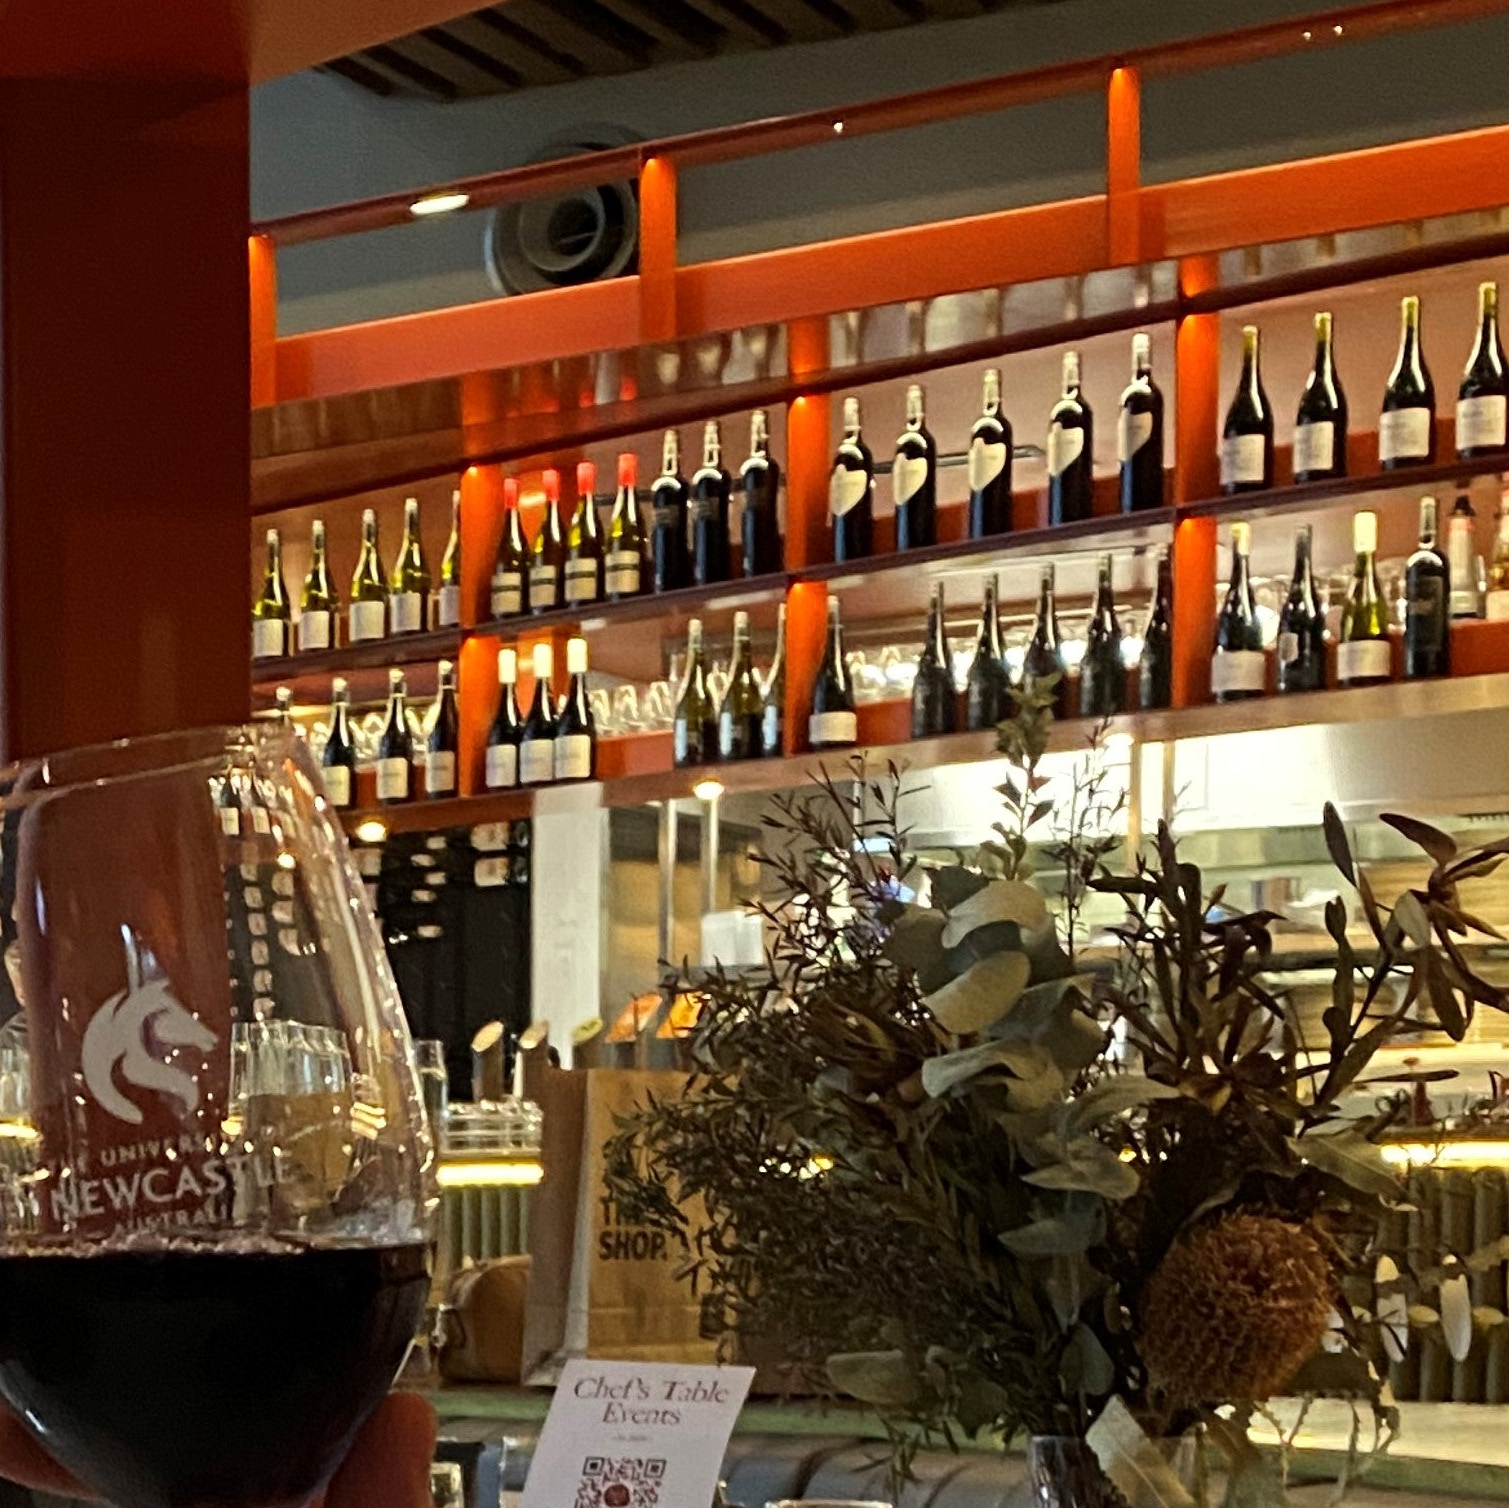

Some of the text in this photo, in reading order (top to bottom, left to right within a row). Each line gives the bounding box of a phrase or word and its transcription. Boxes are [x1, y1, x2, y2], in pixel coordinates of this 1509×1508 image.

[100, 1127, 237, 1167] UNIVERSI
[50, 1150, 293, 1222] NEWCASTLE
[111, 1200, 240, 1236] AUSTRALI
[574, 1376, 730, 1403] Chef's Table
[602, 1402, 681, 1425] Events
